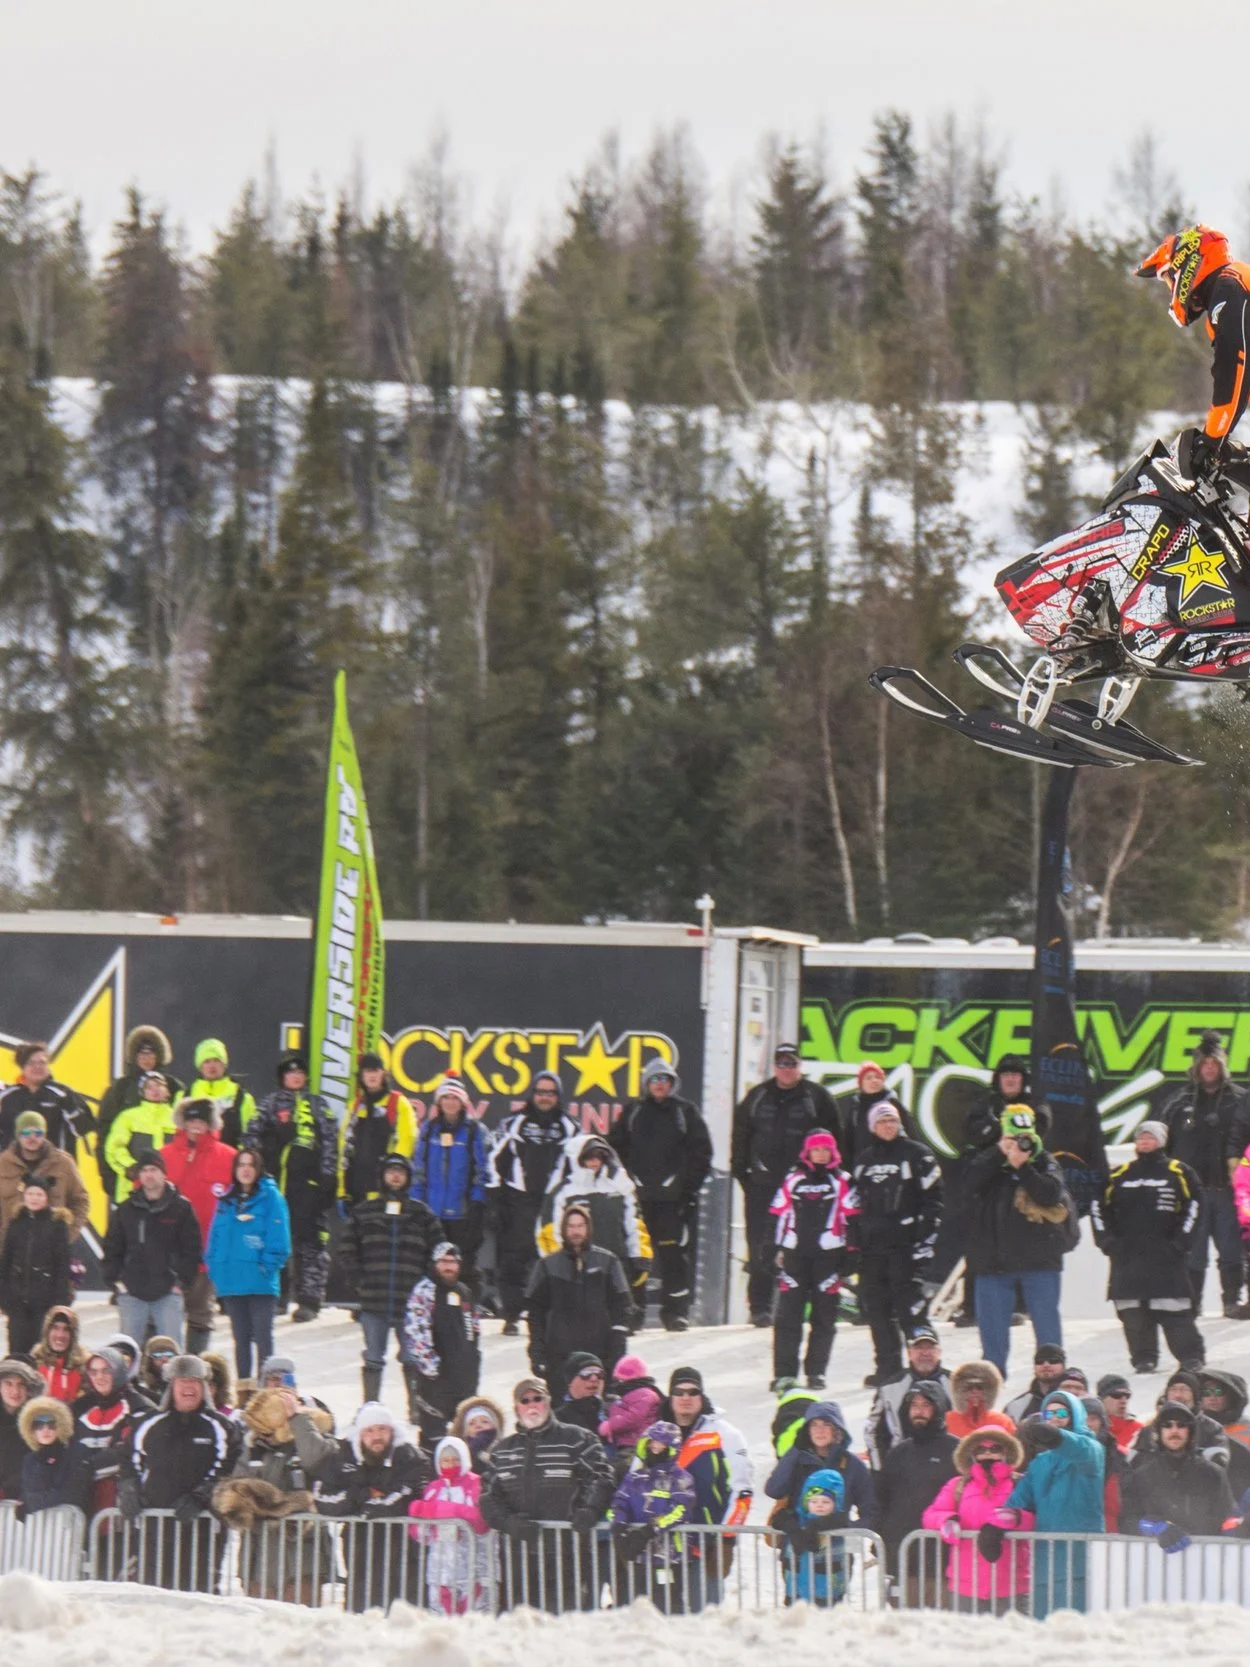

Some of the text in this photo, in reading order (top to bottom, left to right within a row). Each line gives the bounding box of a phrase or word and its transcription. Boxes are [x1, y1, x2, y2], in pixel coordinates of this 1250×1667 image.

[1132, 524, 1169, 580] CRAPO
[320, 859, 359, 1128] IVERSIDE
[281, 1023, 678, 1098] CKSTAR
